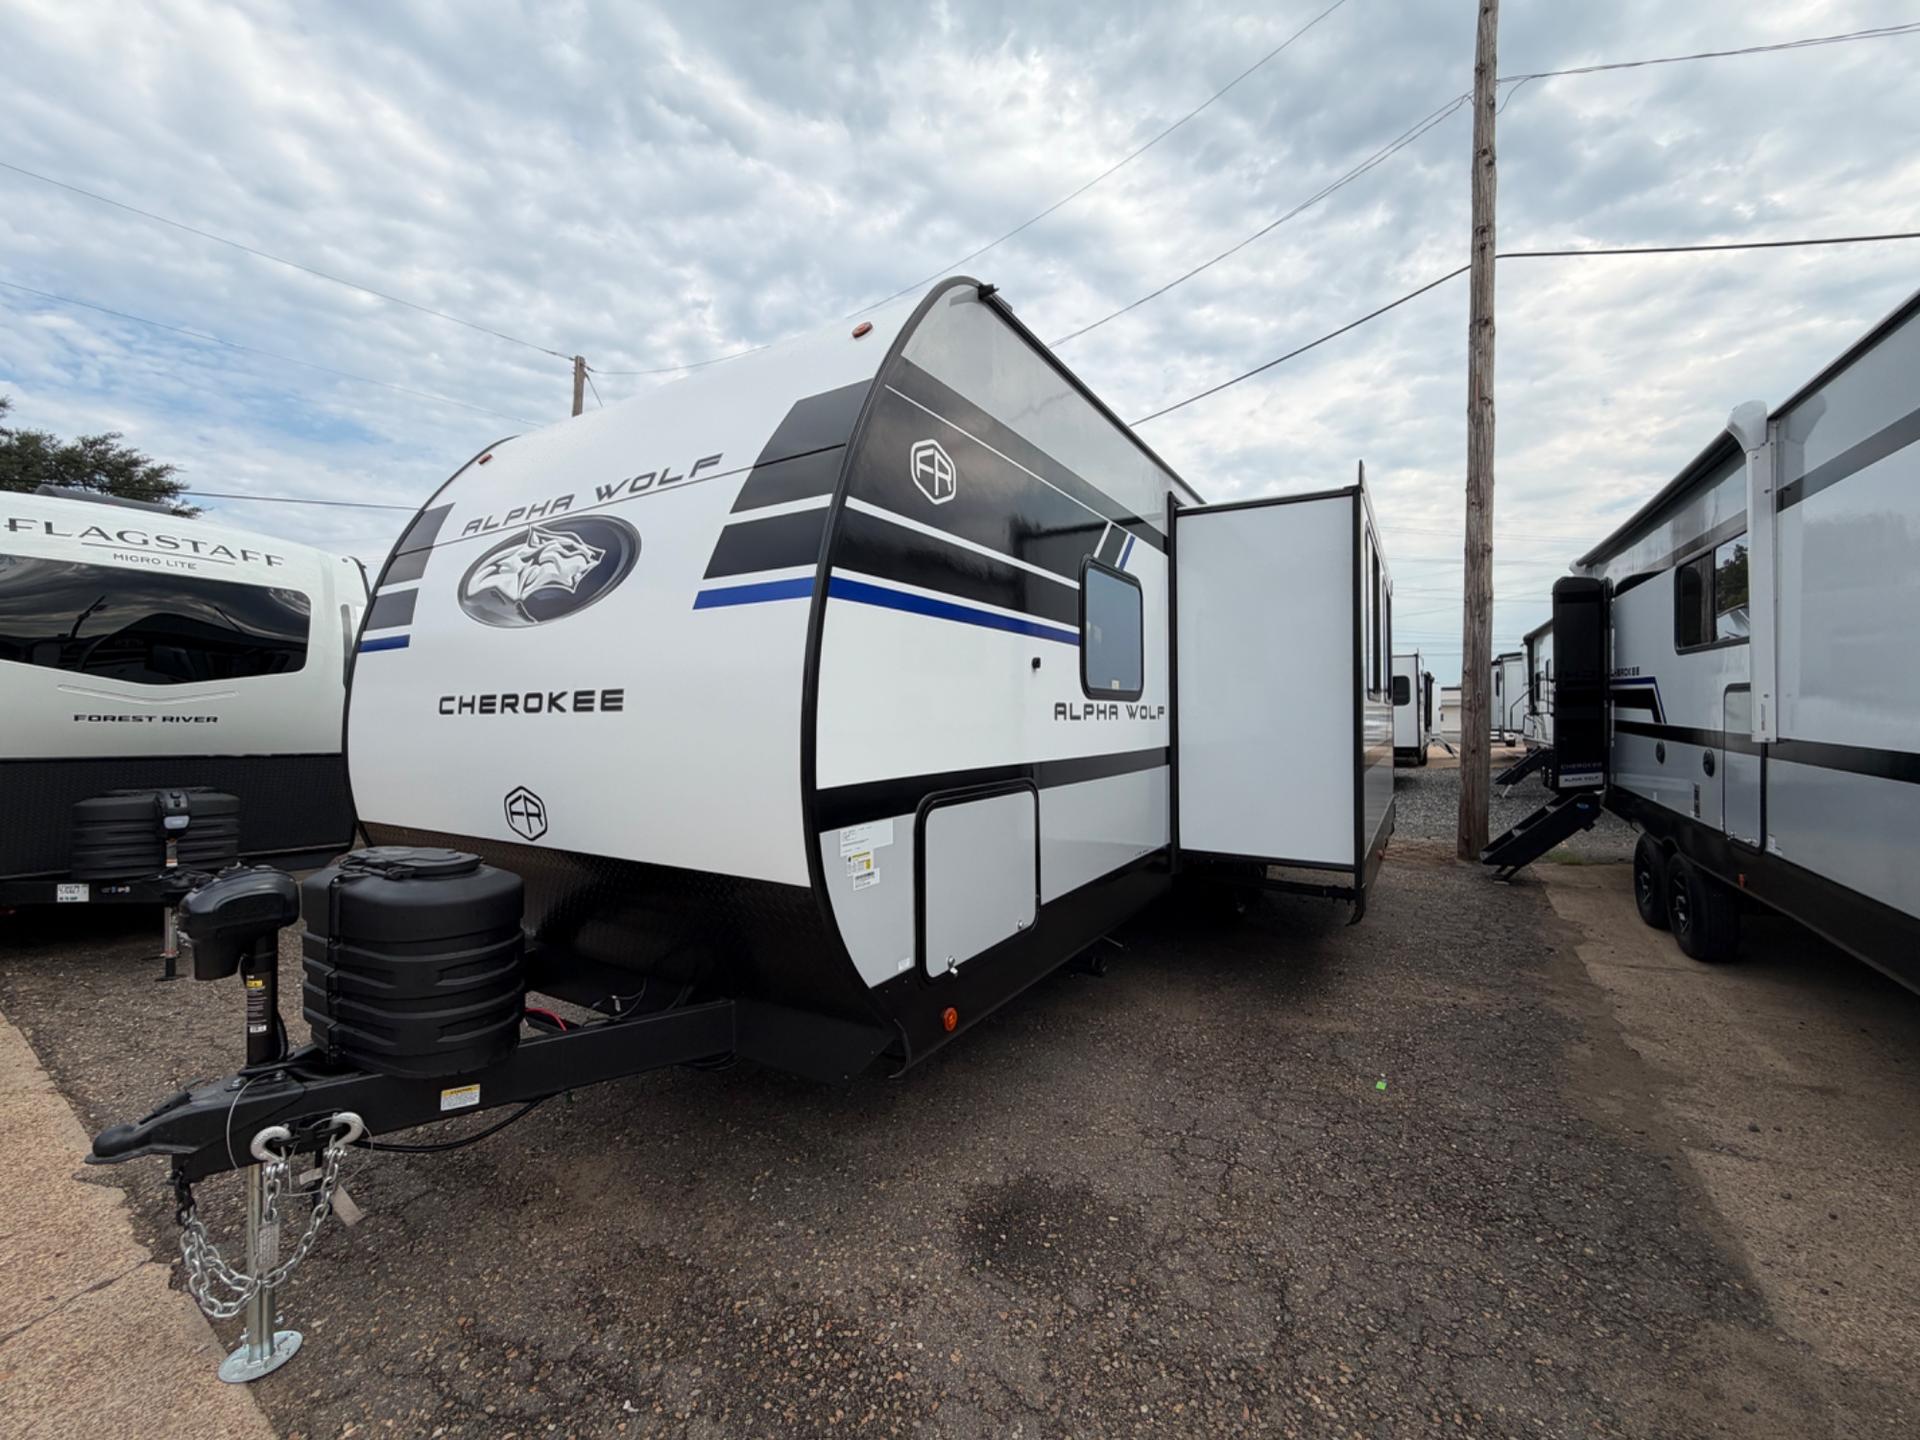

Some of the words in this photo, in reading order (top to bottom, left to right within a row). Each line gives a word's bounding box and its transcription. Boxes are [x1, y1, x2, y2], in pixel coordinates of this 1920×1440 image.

[461, 494, 576, 537] ALPHA
[595, 453, 724, 502] WOLF
[4, 518, 286, 567] FLAGSTAFF
[113, 553, 161, 565] MICRO
[166, 560, 197, 570] LITE
[439, 688, 625, 715] CHEROKEE
[1054, 702, 1119, 720] ALPHA
[1126, 704, 1165, 720] WOLF
[73, 714, 157, 723] FOREST
[161, 715, 219, 723] RIVER
